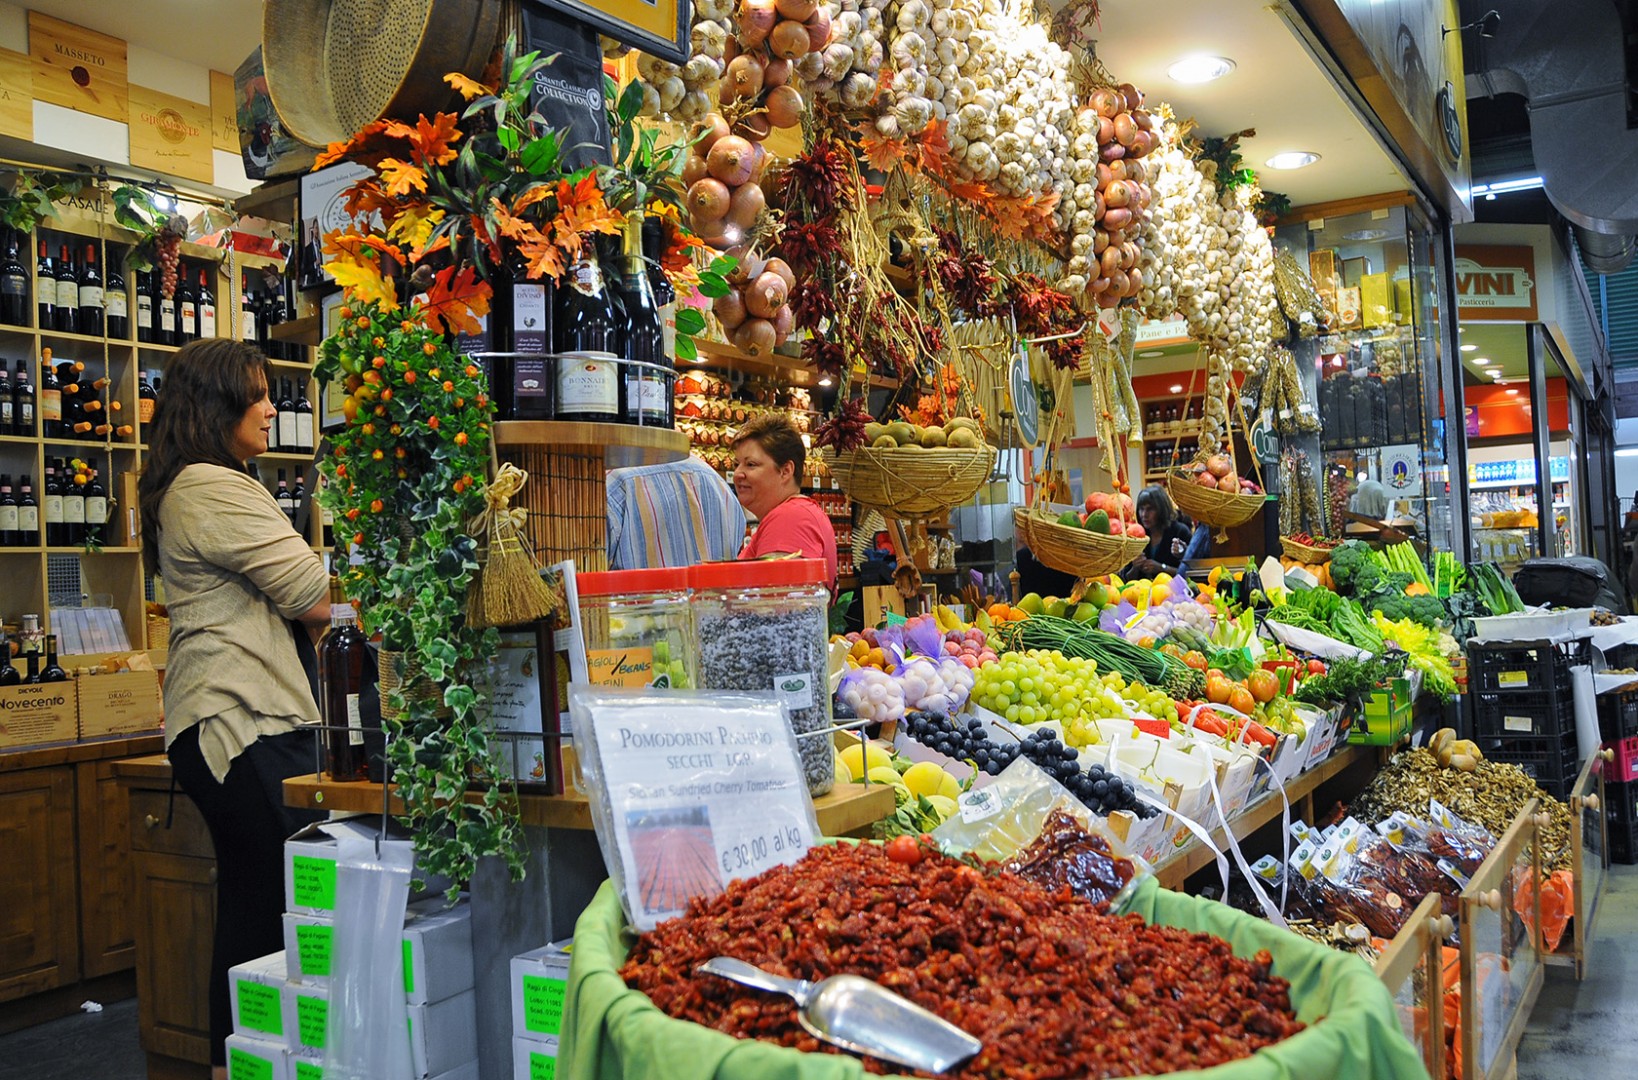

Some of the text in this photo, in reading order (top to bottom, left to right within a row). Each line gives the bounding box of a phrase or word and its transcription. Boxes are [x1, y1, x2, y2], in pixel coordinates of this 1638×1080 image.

[54, 43, 105, 66] MASSETO
[536, 84, 589, 107] COLLECTION
[140, 112, 200, 137] GIRAMONTE
[55, 196, 110, 215] CASALE
[1459, 298, 1496, 306] Pasticceria
[1140, 330, 1162, 338] Pane
[18, 686, 43, 695] DIEVOLE
[108, 691, 133, 699] DRAGO
[0, 695, 65, 711] Novecento
[619, 726, 773, 749] POMODORINI PACHINO
[666, 754, 714, 770] SECCHI
[628, 785, 665, 800] Sican
[668, 781, 713, 797] Sundried
[714, 781, 744, 796] Cherry
[722, 850, 732, 873] €
[773, 828, 785, 852] al
[784, 825, 802, 849] kg
